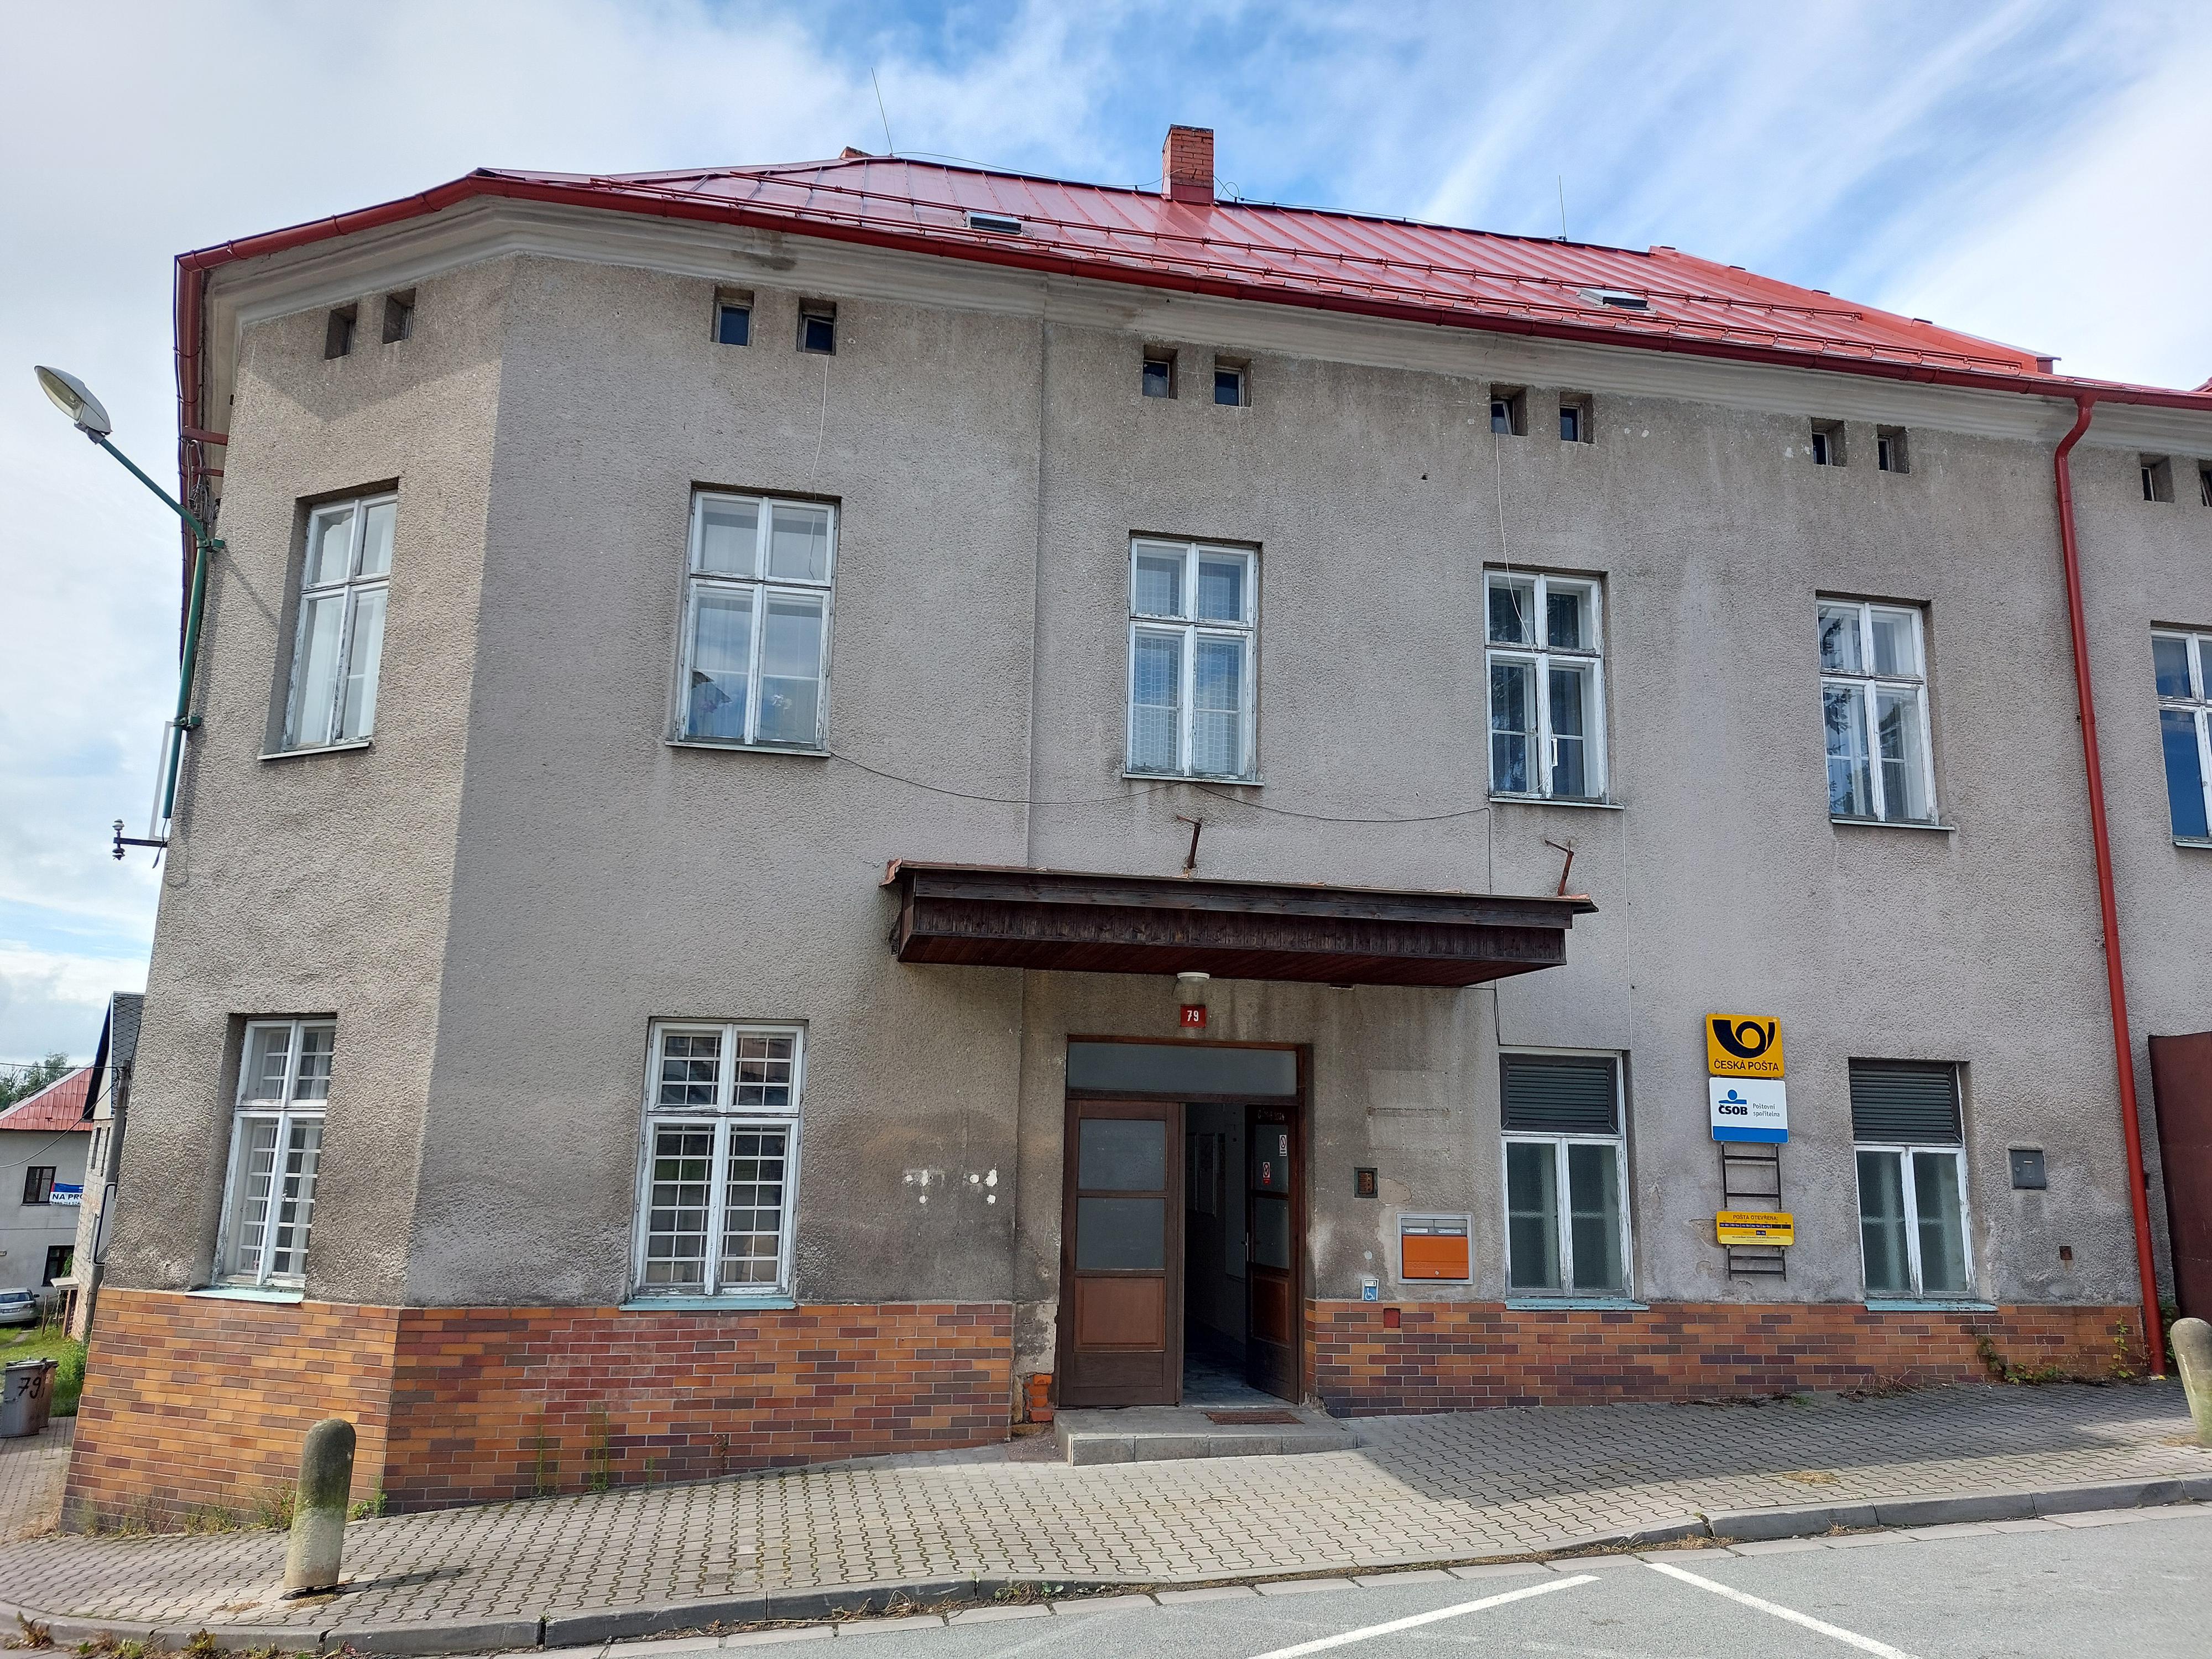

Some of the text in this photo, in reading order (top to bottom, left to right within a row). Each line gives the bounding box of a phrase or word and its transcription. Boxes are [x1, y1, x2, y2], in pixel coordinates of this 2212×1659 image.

[1187, 1010, 1199, 1022] 79
[1714, 1058, 1779, 1071] ČESKÁ POŠTA
[1718, 1104, 1748, 1115] ČSOB
[18, 1376, 41, 1399] 79
